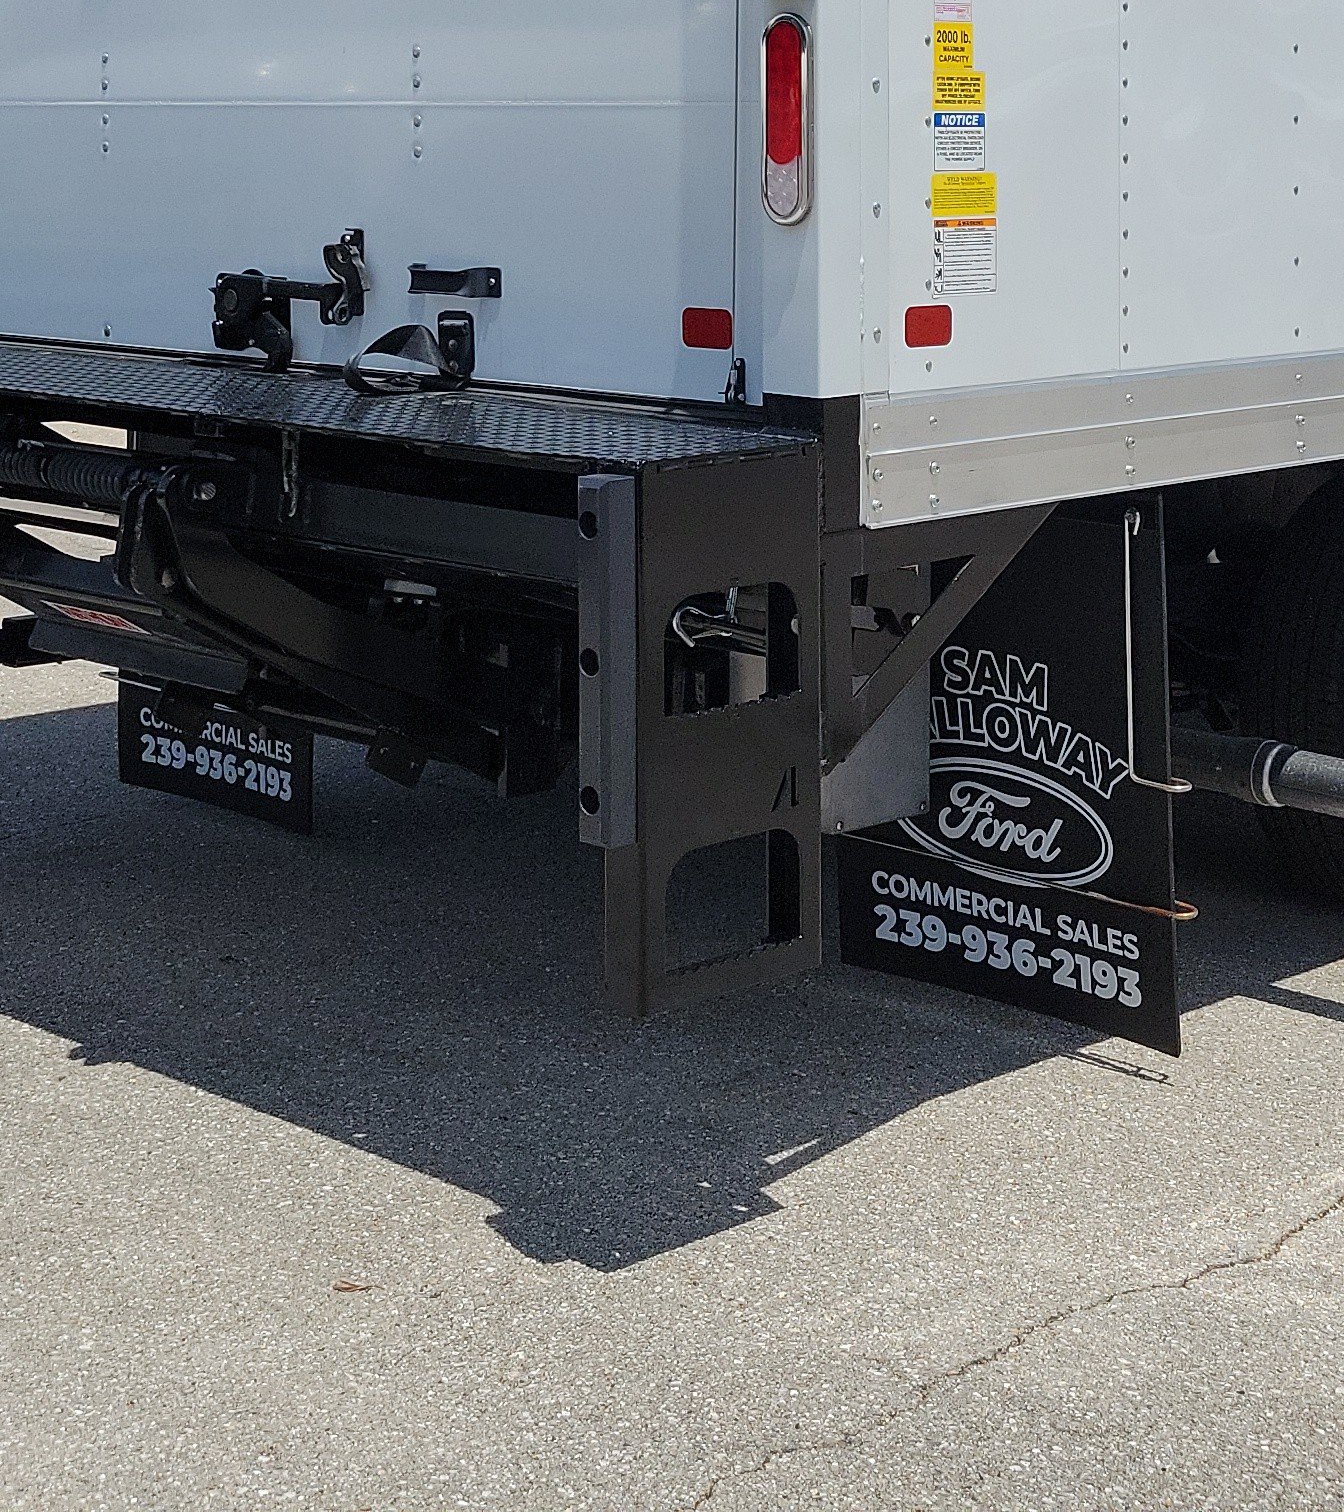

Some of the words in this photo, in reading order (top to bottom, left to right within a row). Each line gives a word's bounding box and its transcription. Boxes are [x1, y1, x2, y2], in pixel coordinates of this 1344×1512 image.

[936, 29, 958, 44] 2000
[960, 29, 972, 45] lb.
[938, 54, 970, 63] CAPACITY
[940, 114, 980, 127] NOTICE
[941, 646, 1048, 711] SAM
[140, 707, 246, 750] CORCIAL
[248, 732, 292, 764] SALES
[140, 733, 292, 802] 239-936-2193
[930, 696, 1130, 799] LLOWAY
[939, 781, 1063, 862] Ford
[871, 870, 1051, 936] COMMERCIAL
[1056, 914, 1140, 960] SALES
[873, 903, 1143, 1008] 239-936-2193
